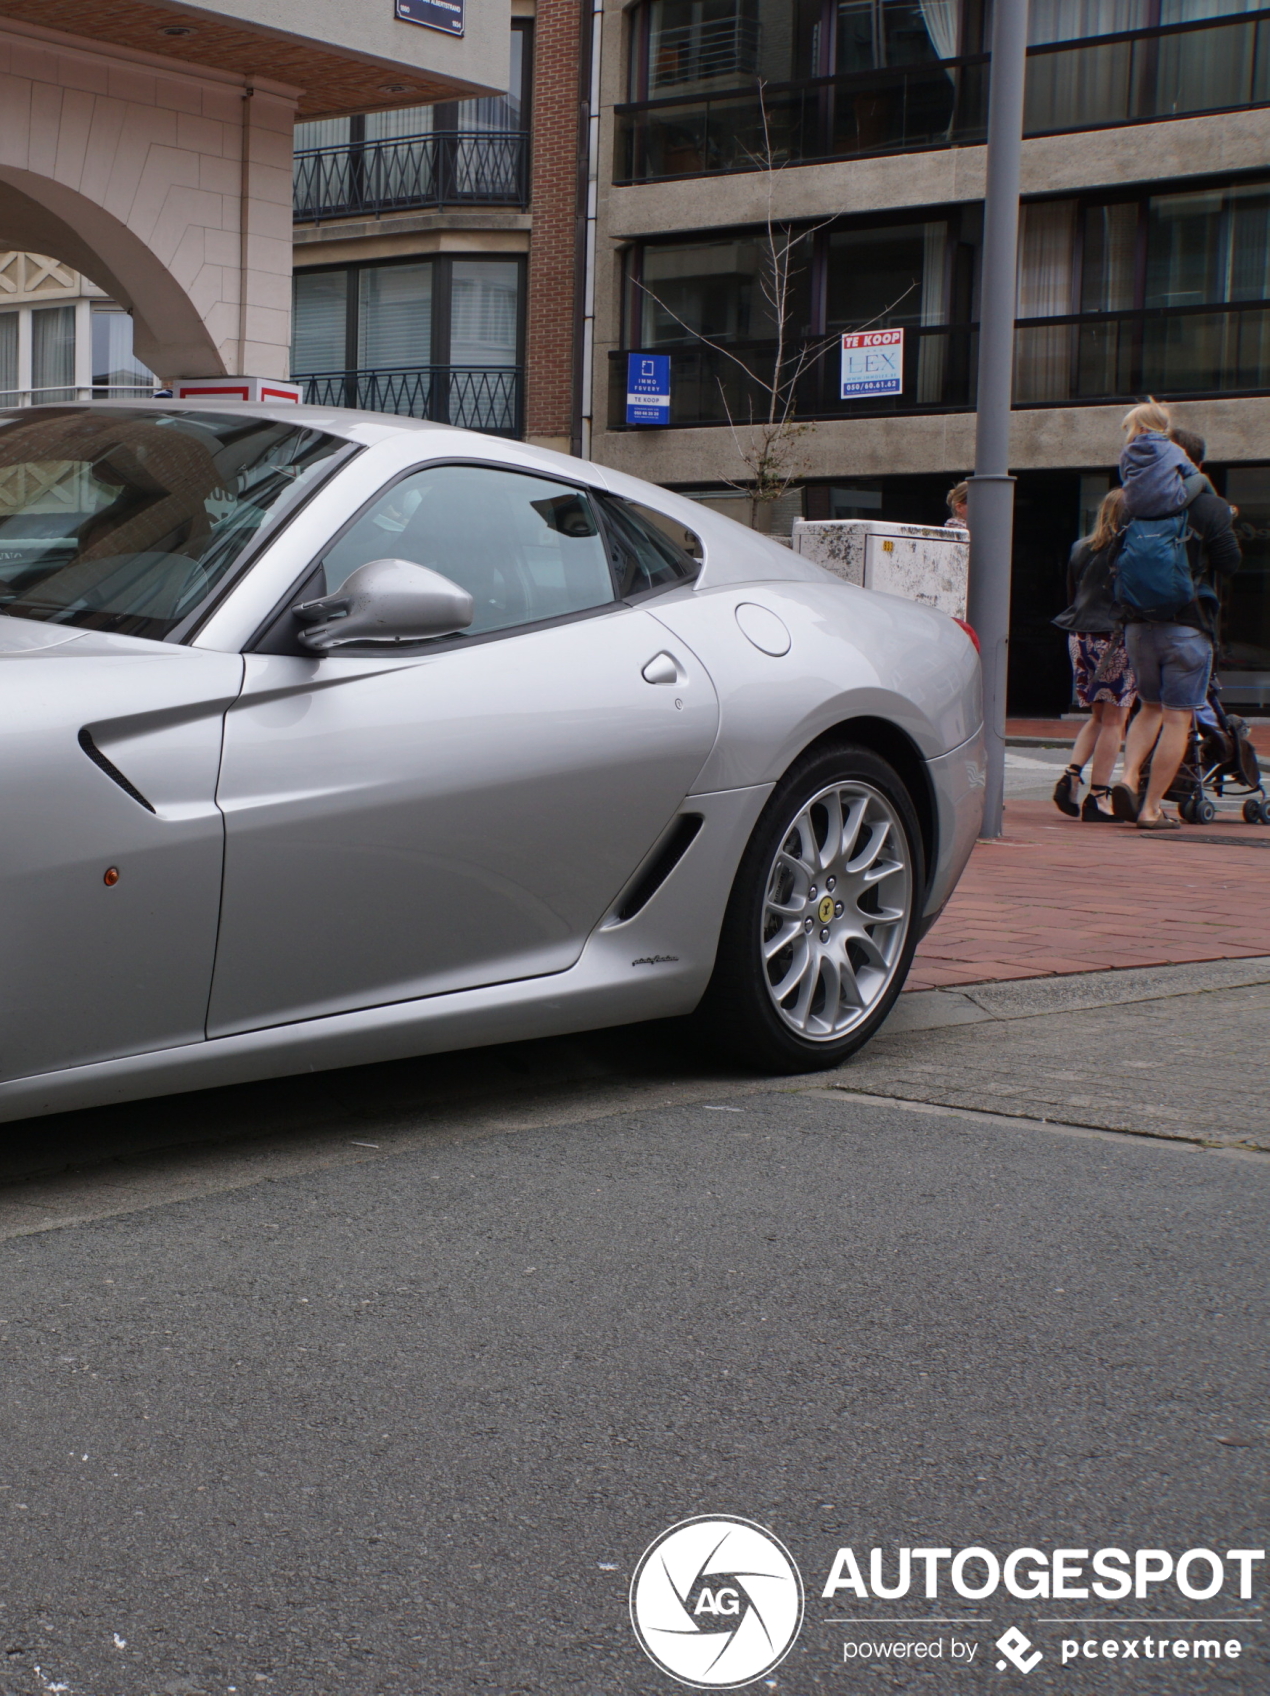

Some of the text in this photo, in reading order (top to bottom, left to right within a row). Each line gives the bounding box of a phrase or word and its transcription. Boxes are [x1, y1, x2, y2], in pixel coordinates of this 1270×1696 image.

[846, 332, 900, 348] TE KOOP
[849, 353, 896, 374] LEX
[846, 380, 897, 391] 050/60.61.62
